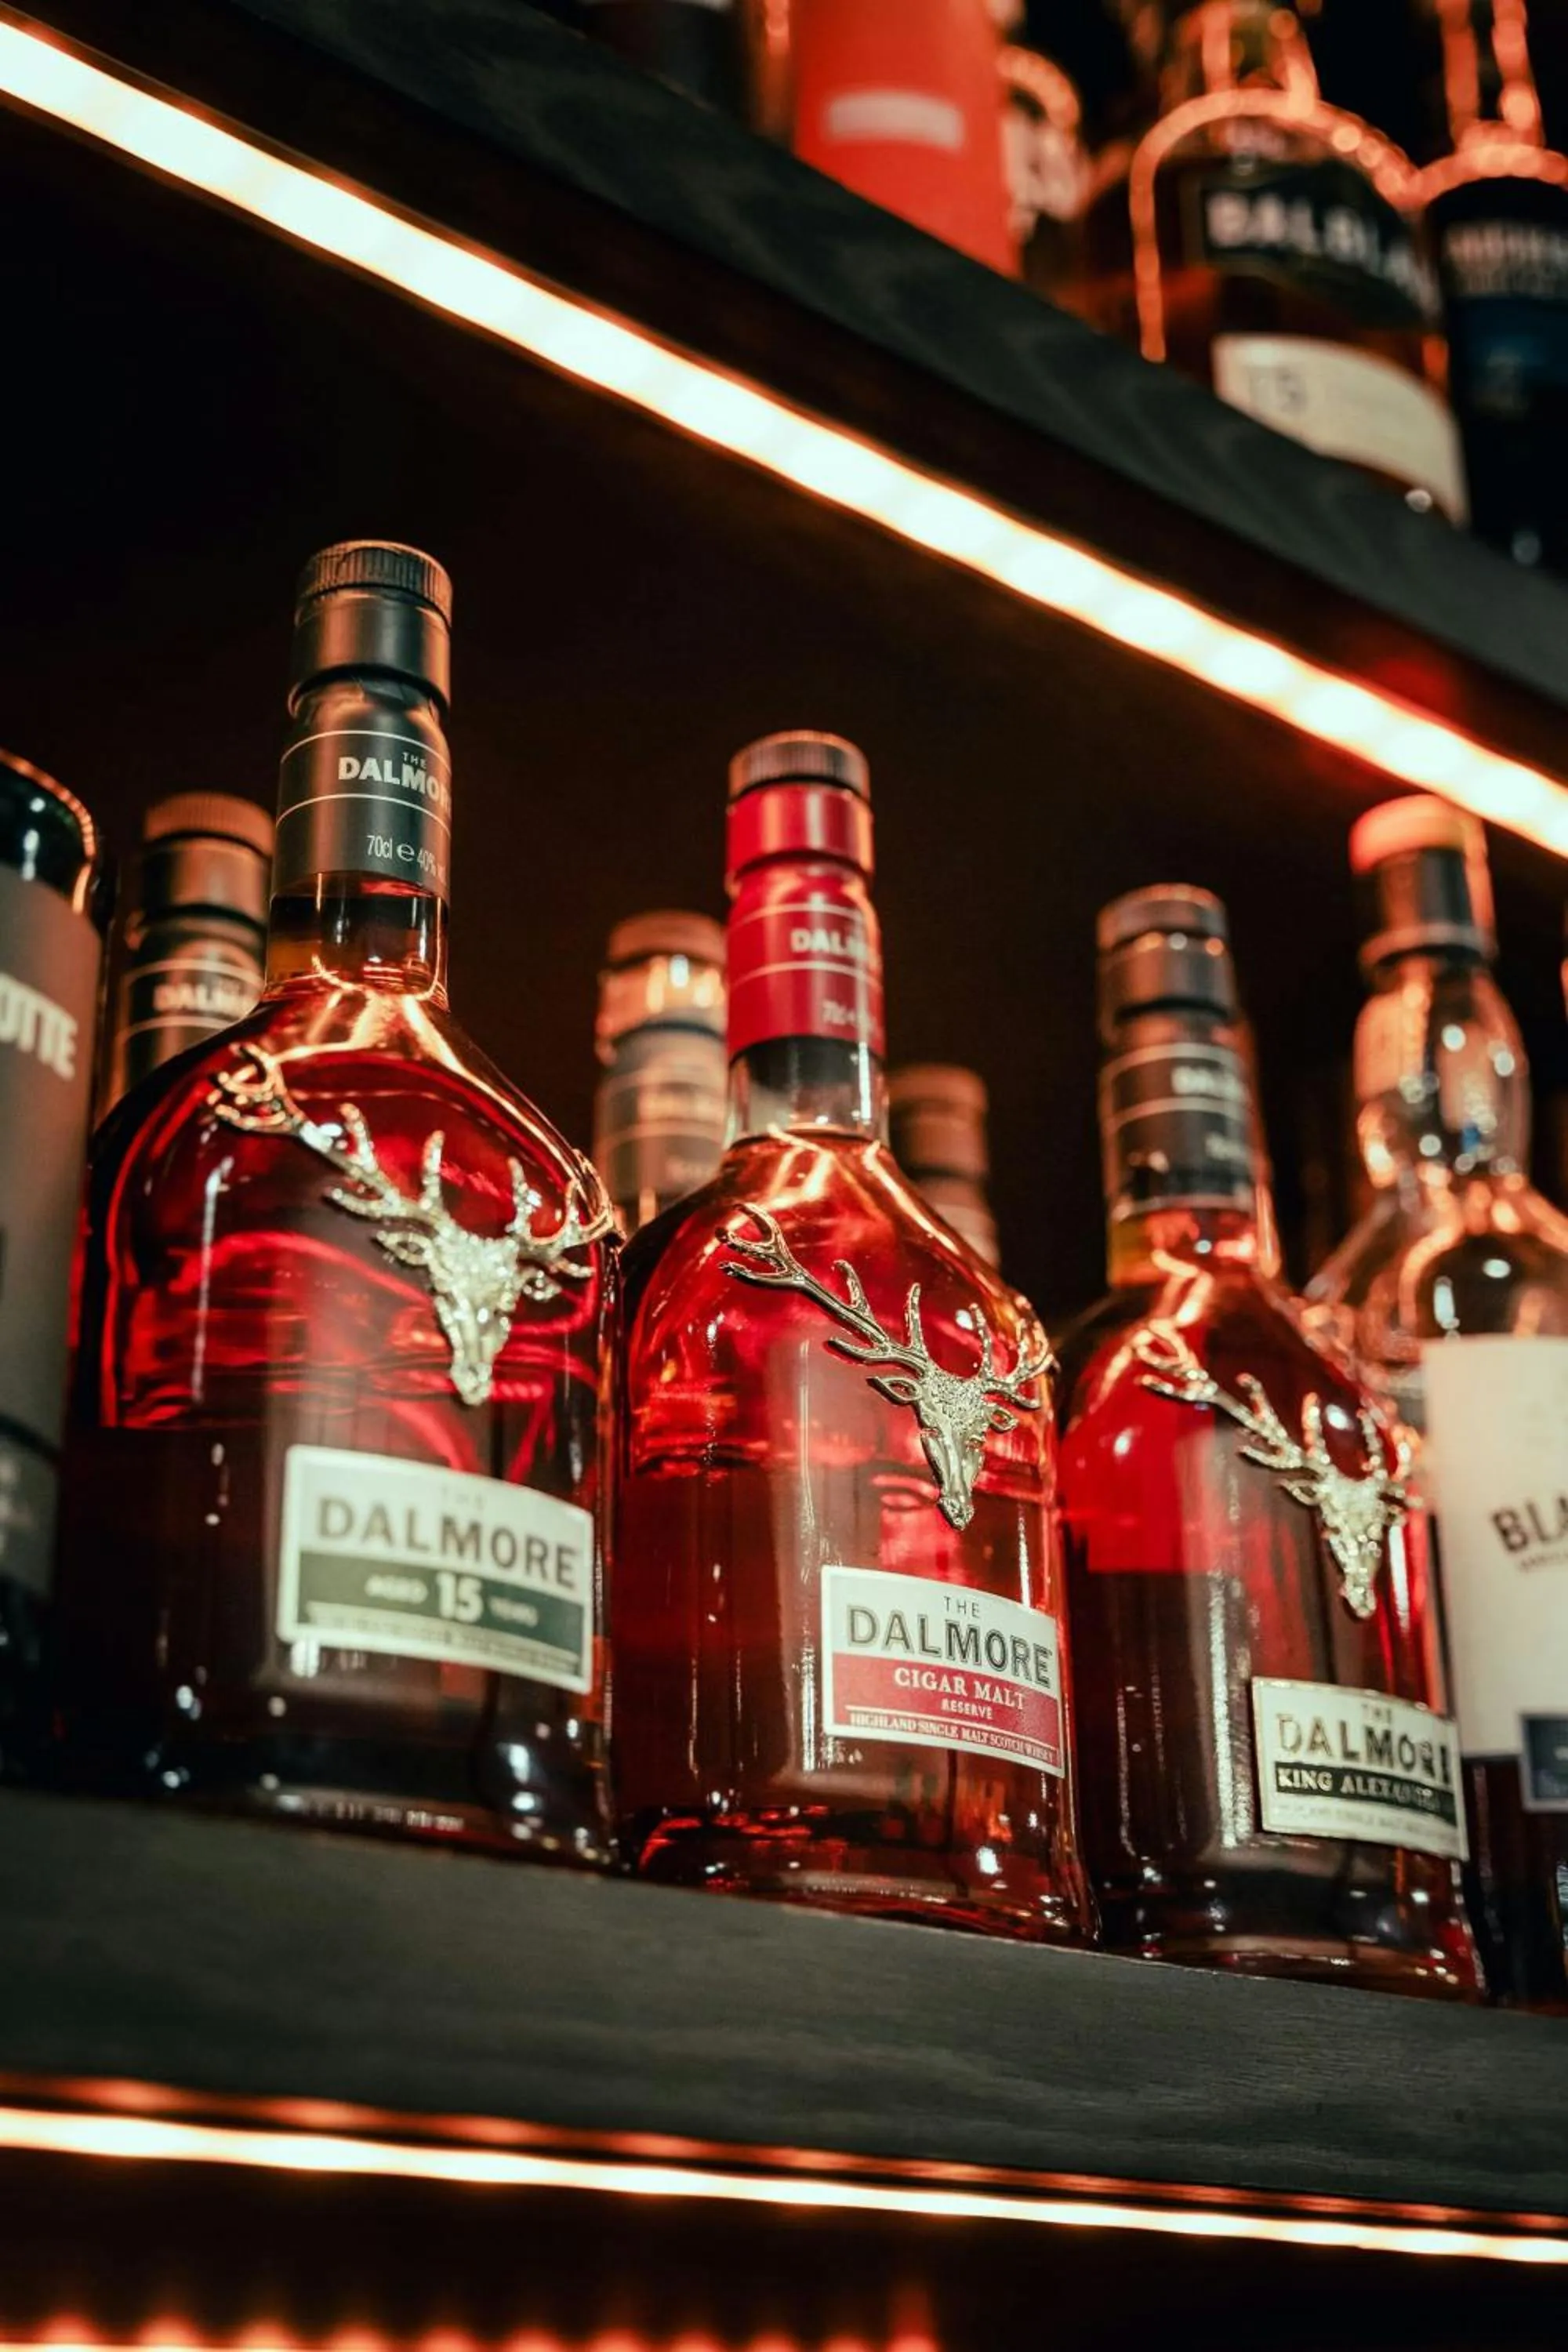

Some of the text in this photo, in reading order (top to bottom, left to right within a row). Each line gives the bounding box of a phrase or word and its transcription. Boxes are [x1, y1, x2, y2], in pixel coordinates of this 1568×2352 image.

[402, 752, 426, 770] THE
[366, 835, 392, 859] 70cl
[318, 1497, 579, 1589] DALMORE
[436, 1570, 484, 1624] 15
[944, 1595, 980, 1618] THE
[847, 1605, 1054, 1689] DALMORE
[894, 1667, 1025, 1710] CIGAR MALT
[941, 1697, 993, 1721] RESERVE
[850, 1712, 917, 1732] HIGHLAND
[917, 1721, 958, 1739] SINGLE
[961, 1727, 989, 1745] MALT
[989, 1734, 1025, 1753] SCOTCH
[1276, 1766, 1333, 1792] KING
